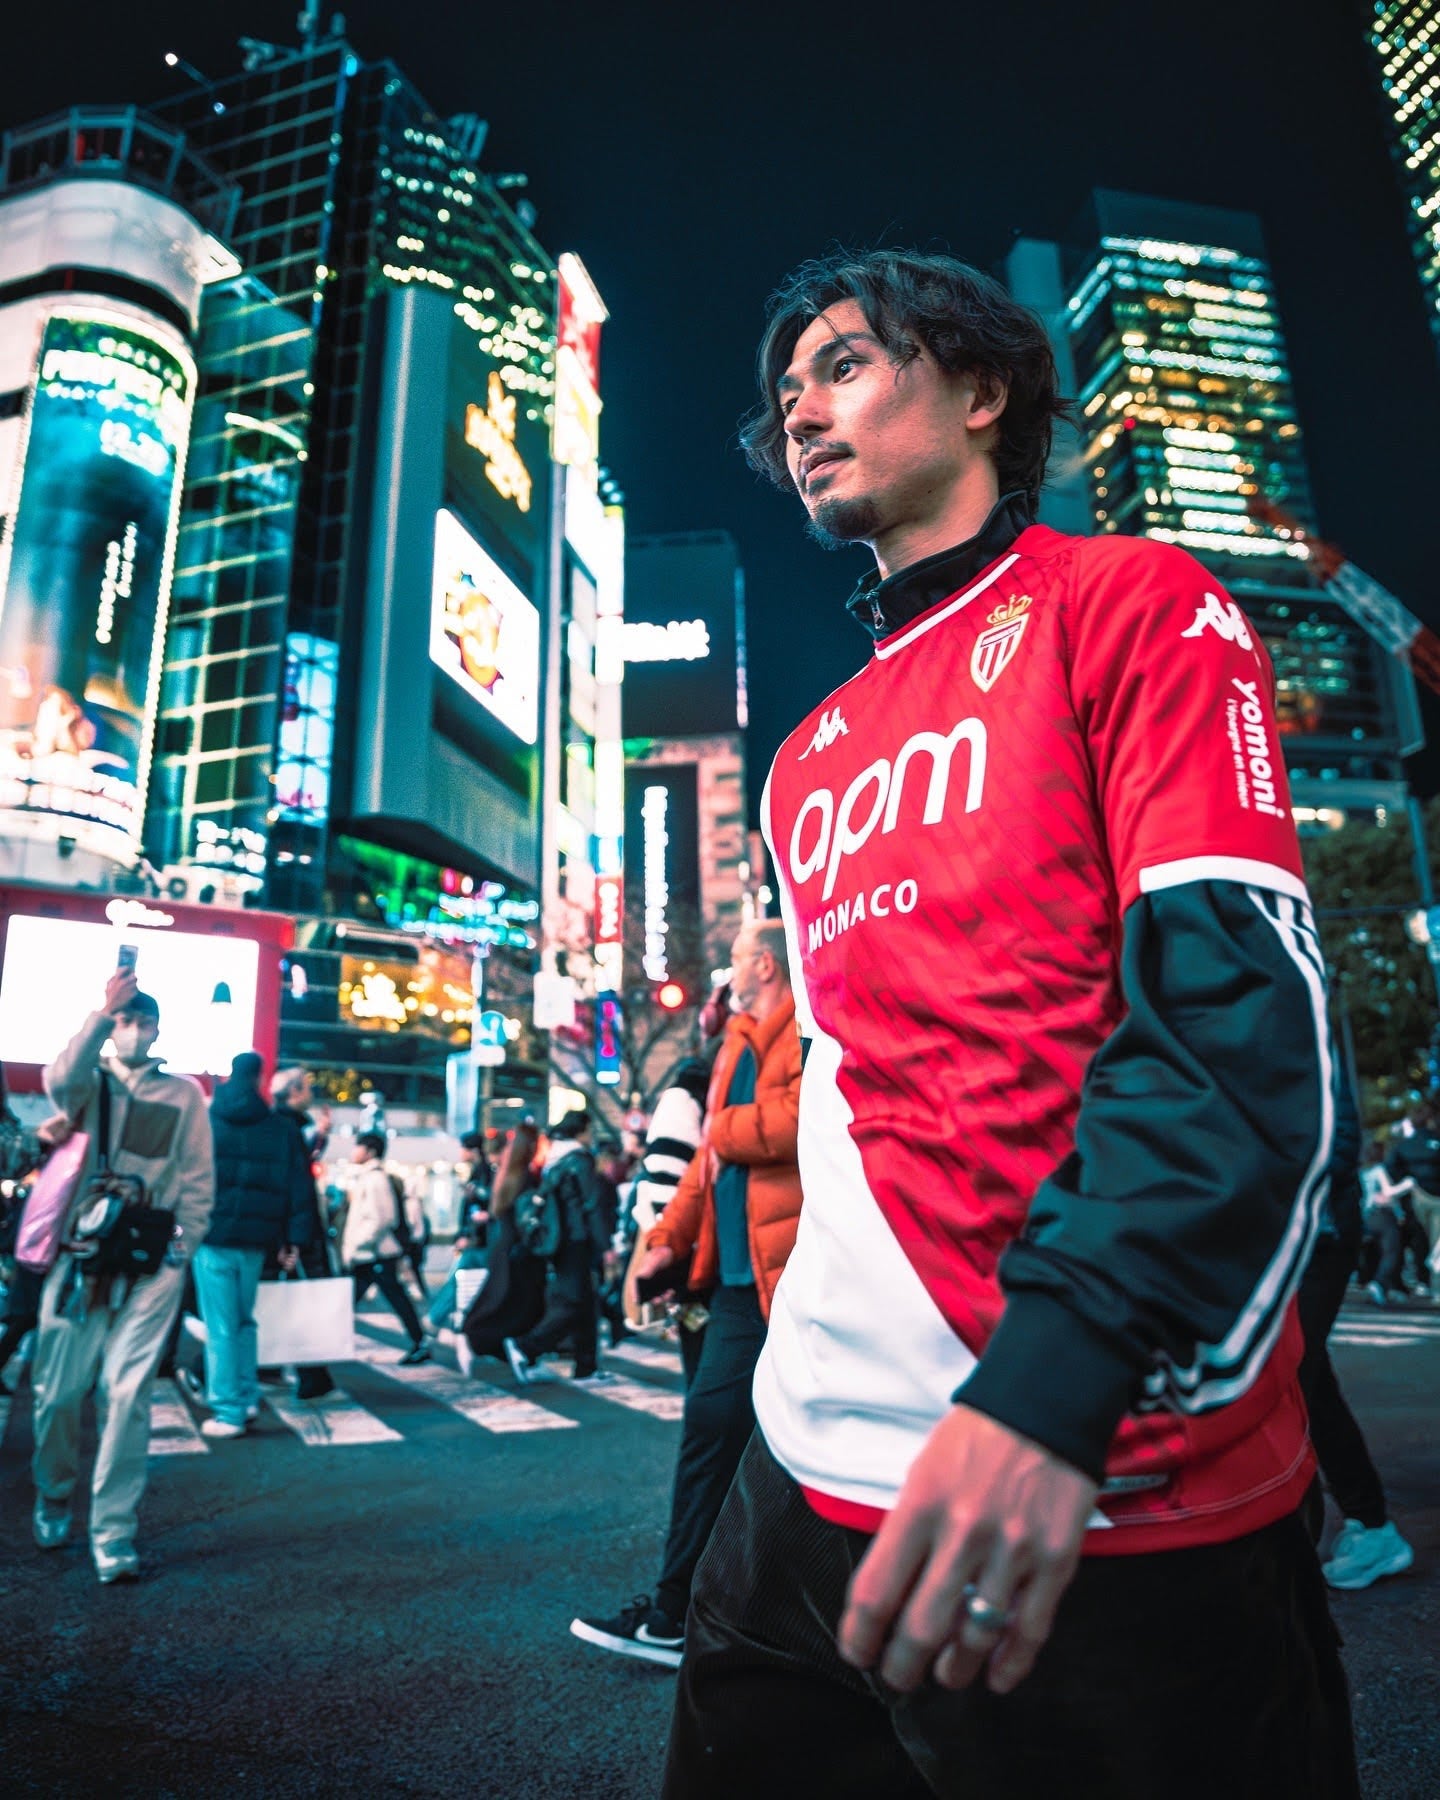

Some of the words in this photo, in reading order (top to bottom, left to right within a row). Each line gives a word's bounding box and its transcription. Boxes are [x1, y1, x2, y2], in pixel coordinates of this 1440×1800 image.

[789, 716, 988, 902] apm
[1231, 677, 1286, 819] yomoni
[808, 878, 919, 954] MONACO
